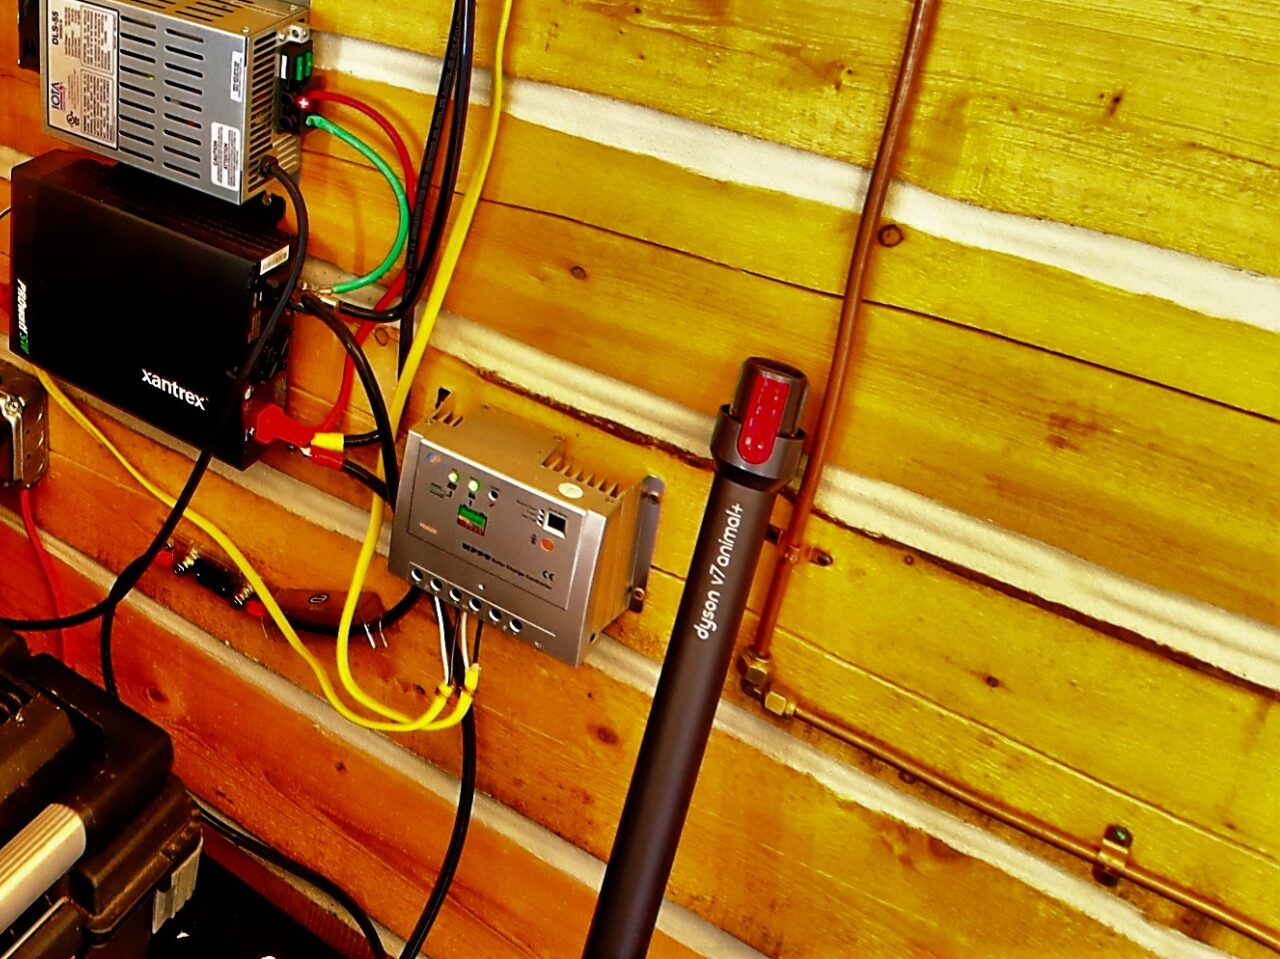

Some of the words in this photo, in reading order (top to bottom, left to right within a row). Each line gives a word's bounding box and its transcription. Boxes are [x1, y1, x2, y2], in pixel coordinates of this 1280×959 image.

[51, 11, 59, 45] DLS-55
[51, 82, 61, 110] IOTA
[141, 368, 206, 411] xantrex
[693, 590, 720, 640] dyson
